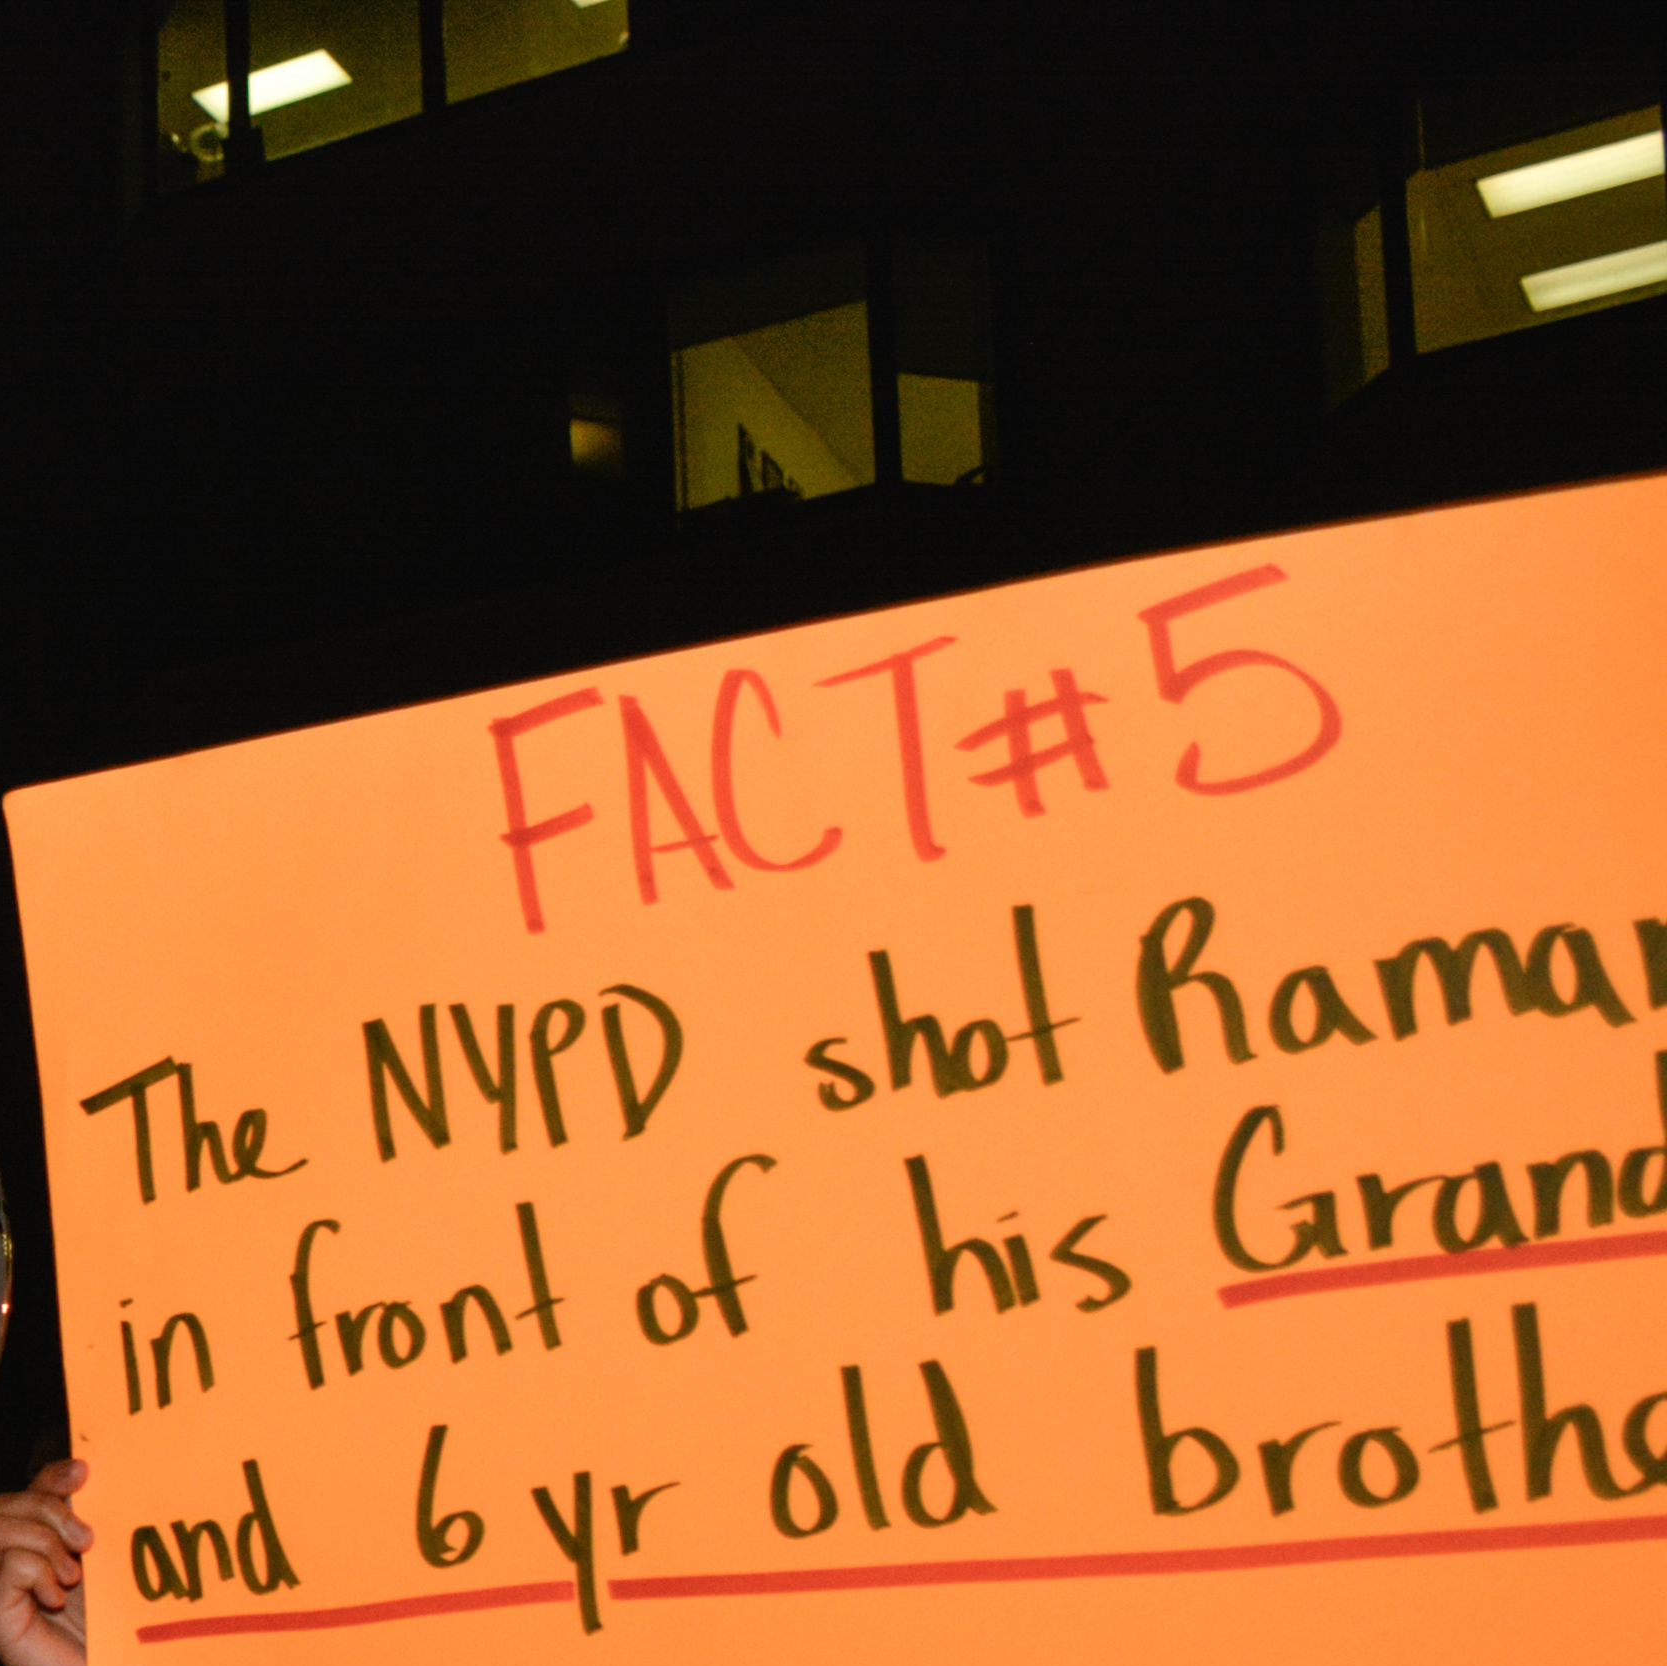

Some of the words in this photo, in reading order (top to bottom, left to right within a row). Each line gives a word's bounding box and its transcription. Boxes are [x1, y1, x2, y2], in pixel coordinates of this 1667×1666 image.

[79, 1054, 309, 1206] The
[362, 981, 685, 1165] NYPD
[803, 903, 1081, 1114] shot
[120, 1299, 215, 1418] in
[288, 1201, 566, 1394] front
[635, 1153, 778, 1351] of
[907, 1155, 1133, 1318] his
[129, 1460, 300, 1607] and
[414, 1424, 486, 1570] 6
[531, 1469, 681, 1636] yr
[768, 1360, 997, 1541] old
